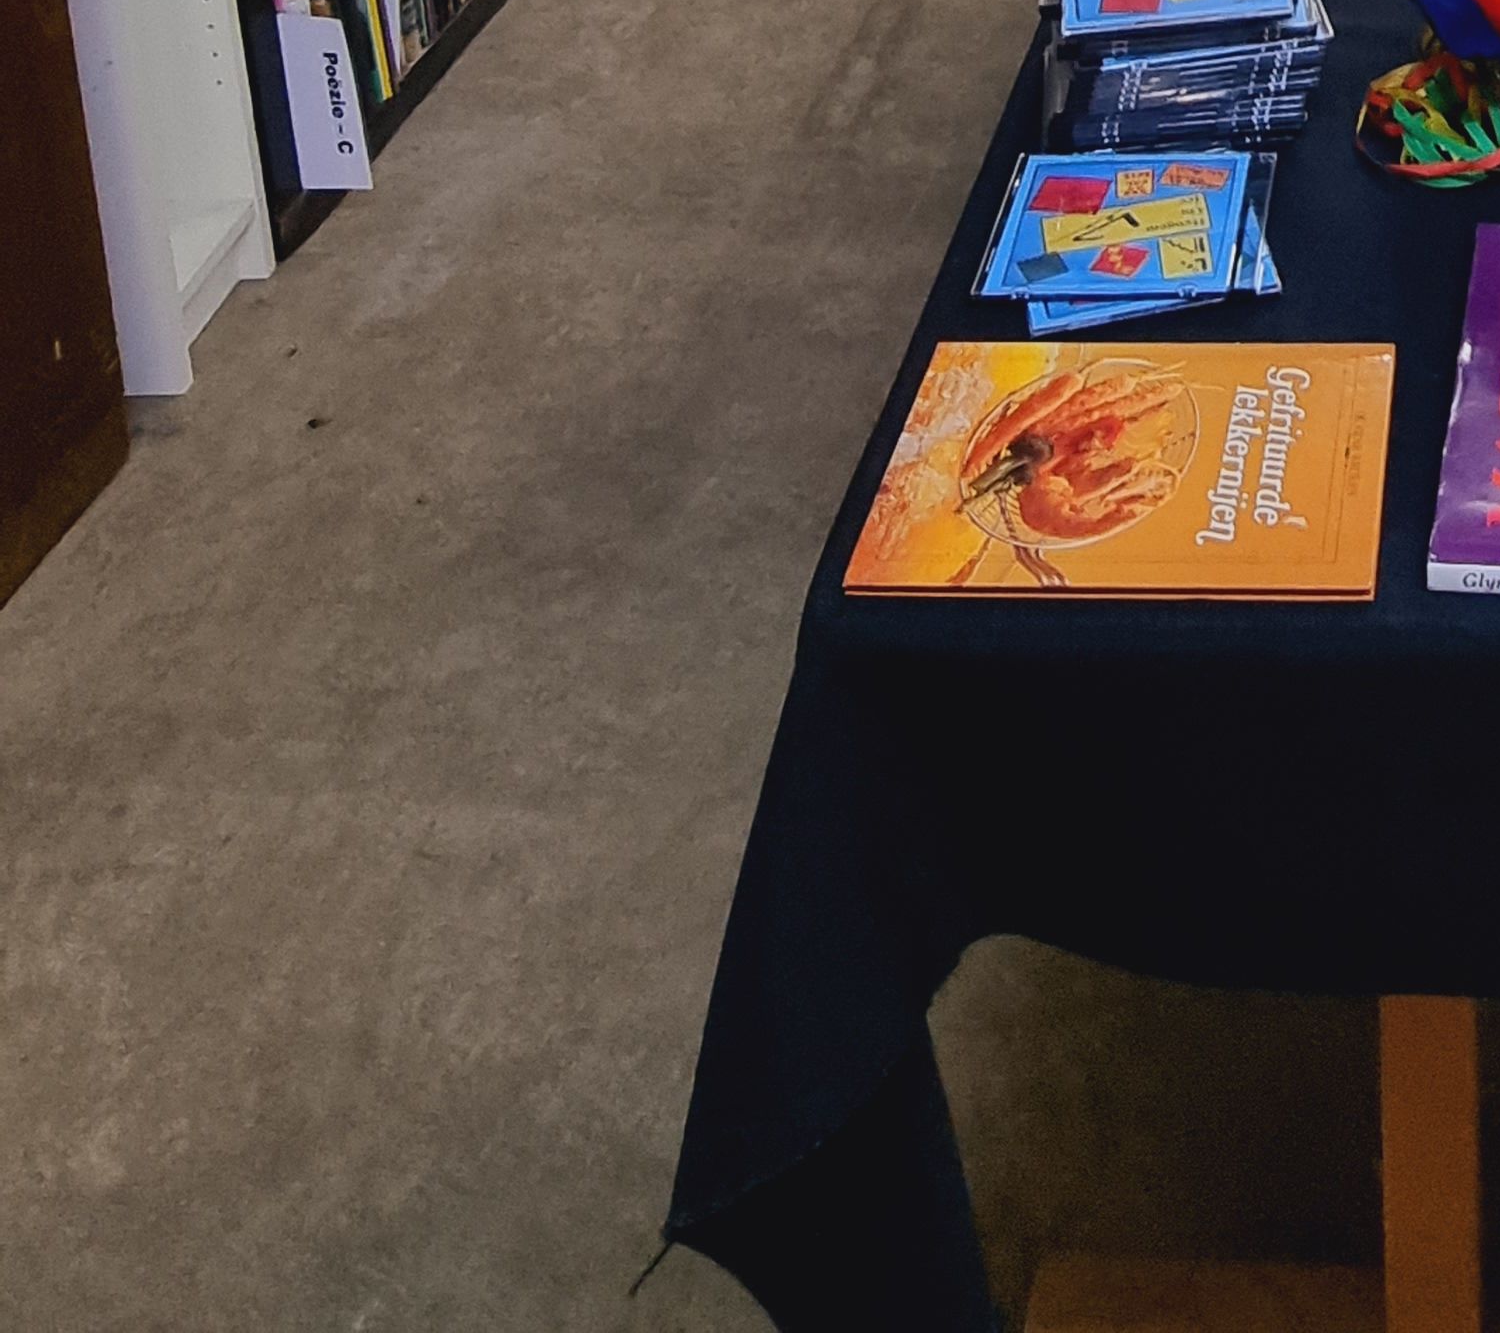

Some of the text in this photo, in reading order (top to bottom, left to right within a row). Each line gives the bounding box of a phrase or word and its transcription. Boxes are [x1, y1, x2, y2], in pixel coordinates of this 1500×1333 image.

[322, 51, 344, 121] Poëzie
[337, 140, 353, 156] C
[1196, 385, 1256, 547] lekkernijen
[1254, 365, 1311, 527] Gefrituurde
